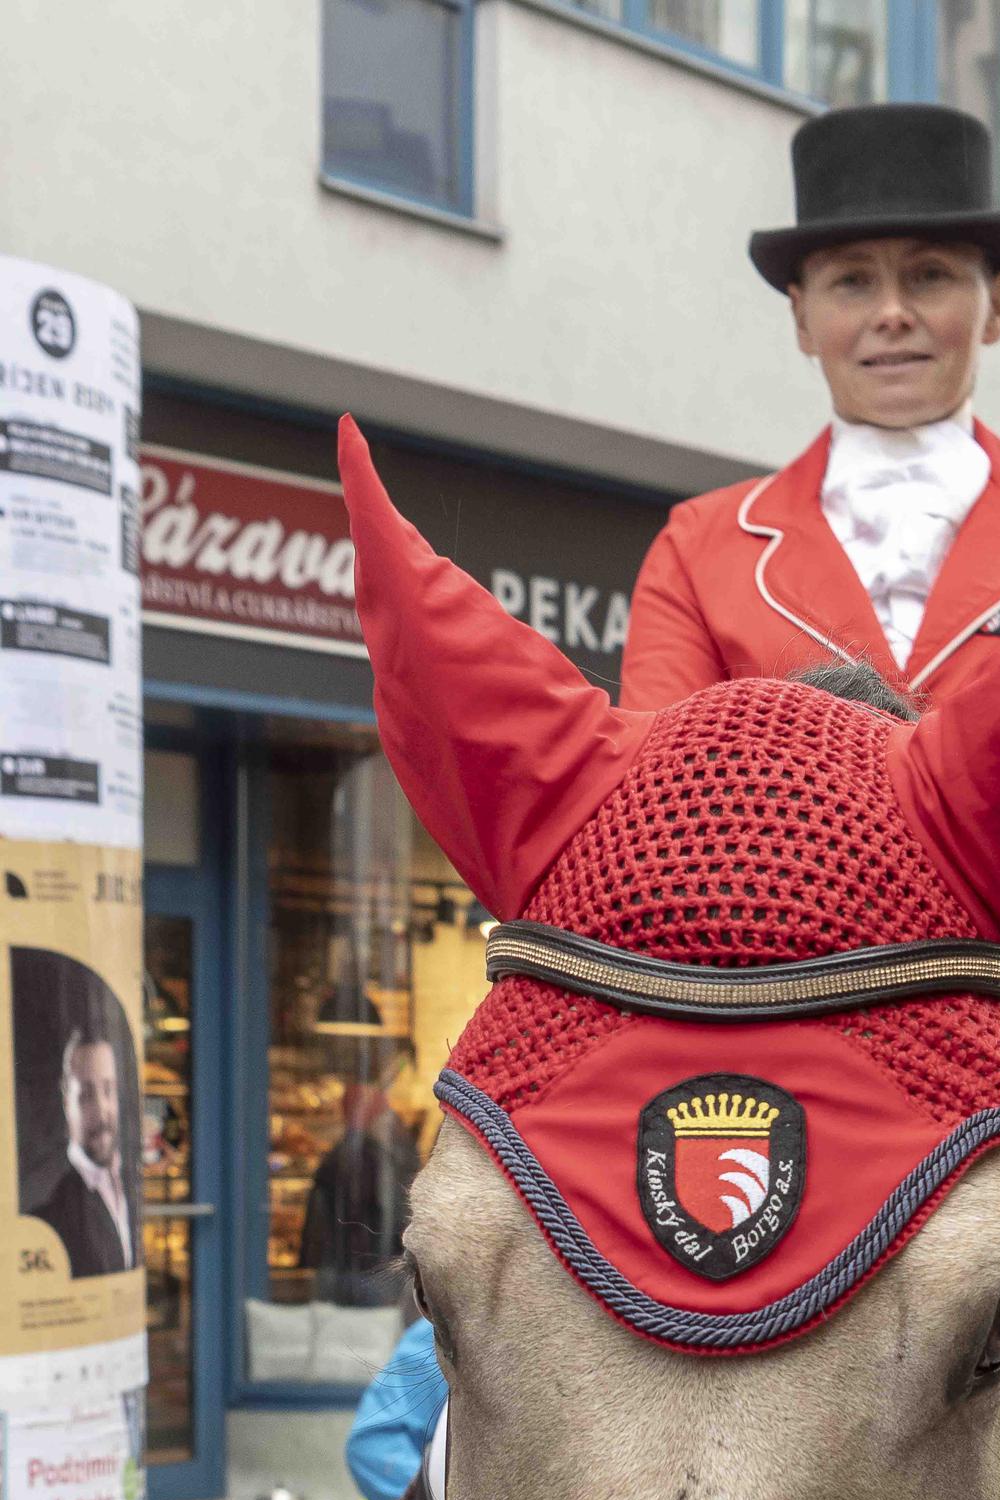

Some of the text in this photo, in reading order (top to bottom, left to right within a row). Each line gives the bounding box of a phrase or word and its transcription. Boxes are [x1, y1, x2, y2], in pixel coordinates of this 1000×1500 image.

[491, 569, 631, 652] PEKA
[643, 1148, 795, 1264] Kinský dal Borgo a.s.
